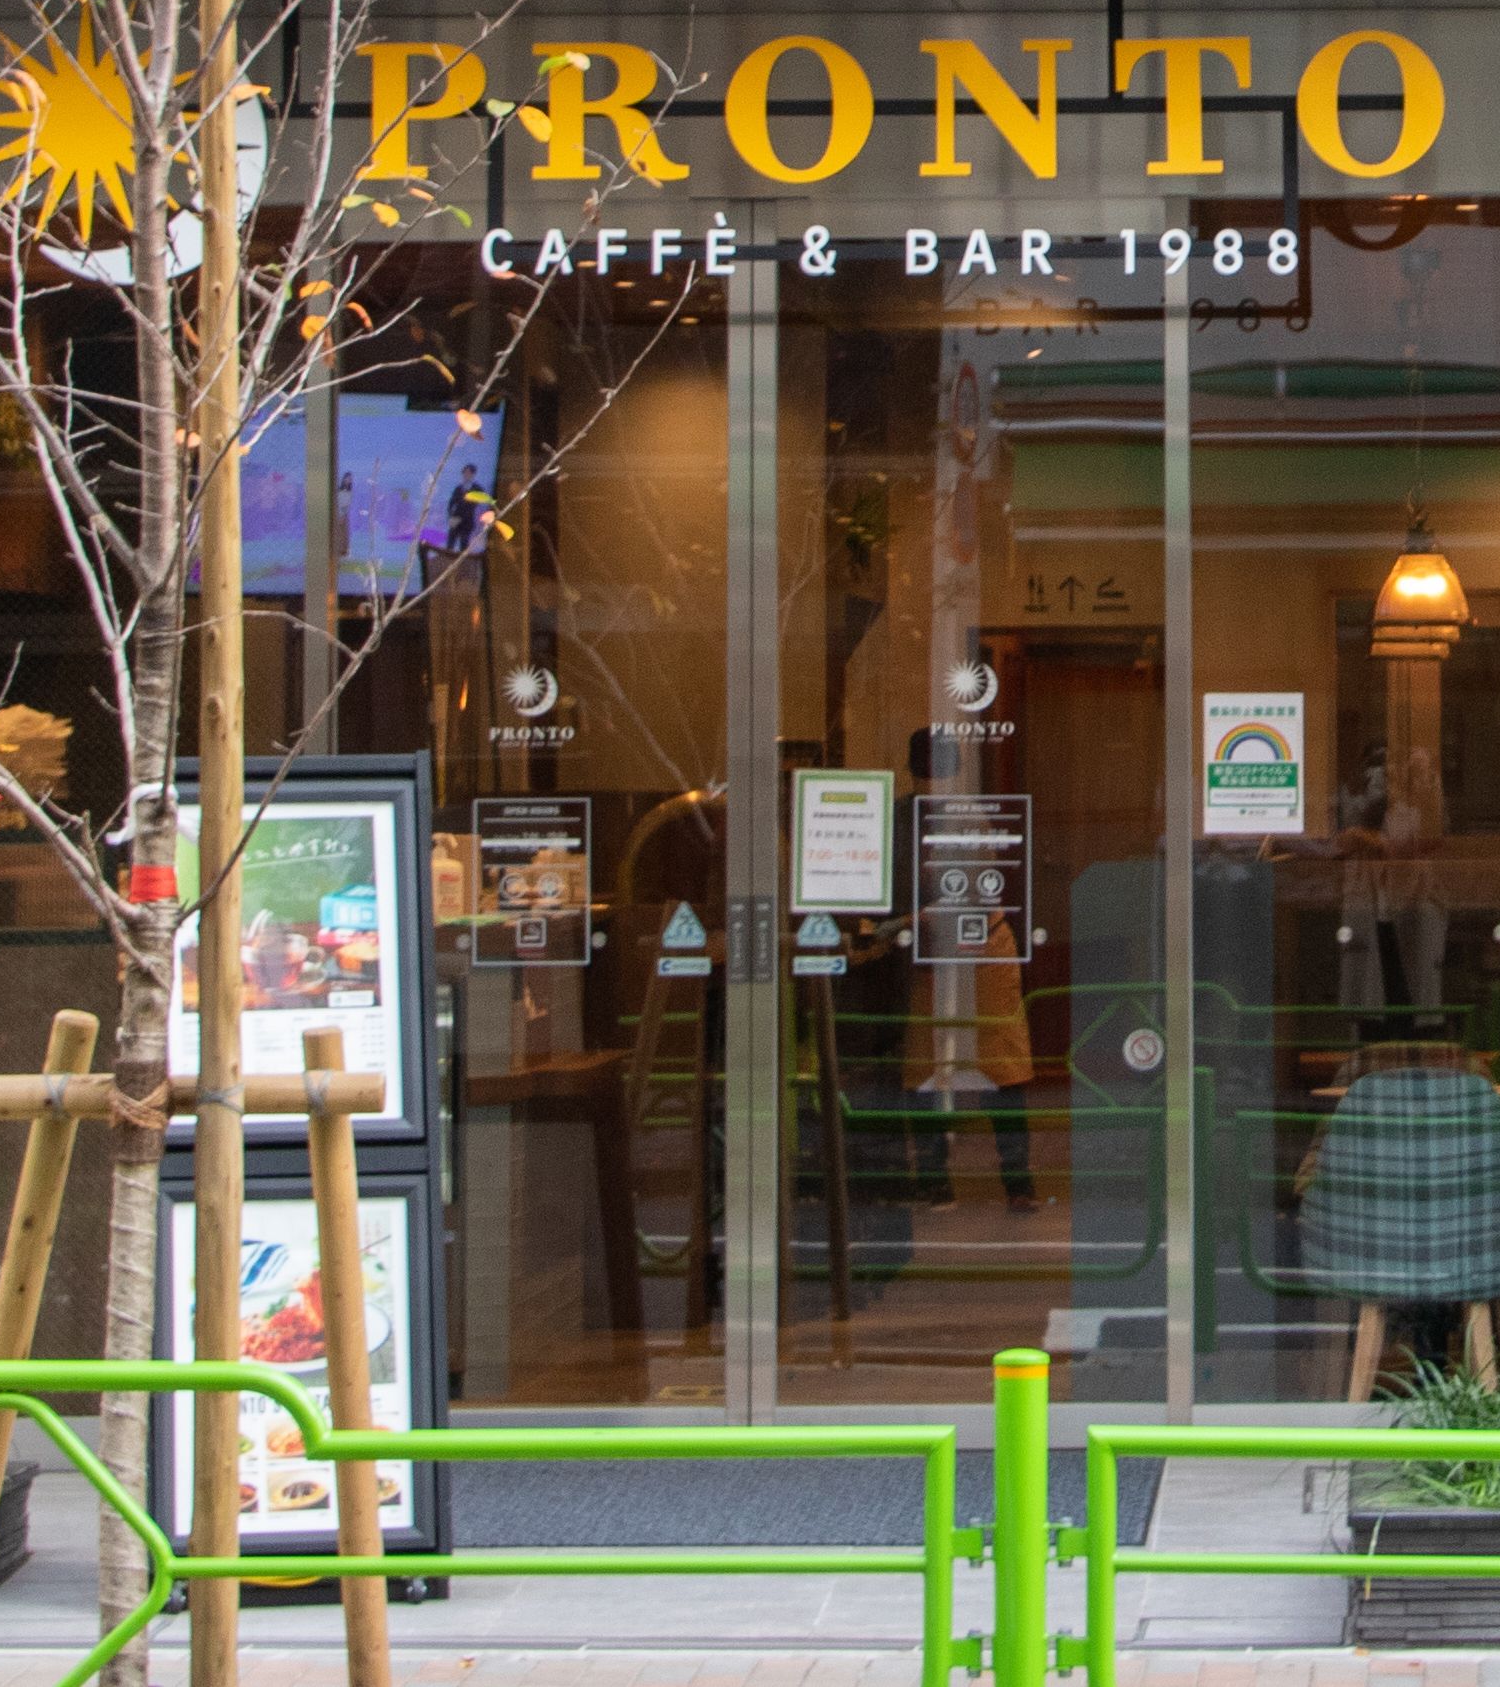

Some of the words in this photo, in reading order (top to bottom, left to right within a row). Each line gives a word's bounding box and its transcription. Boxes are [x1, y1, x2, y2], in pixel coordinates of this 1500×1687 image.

[356, 30, 1446, 184] PRONTO
[481, 211, 738, 277] CAFFÈ
[801, 225, 837, 276] &
[905, 228, 1055, 276] BAR
[1119, 227, 1301, 277] 1988
[488, 725, 576, 742] PRONTO
[930, 720, 1016, 736] PRONTO
